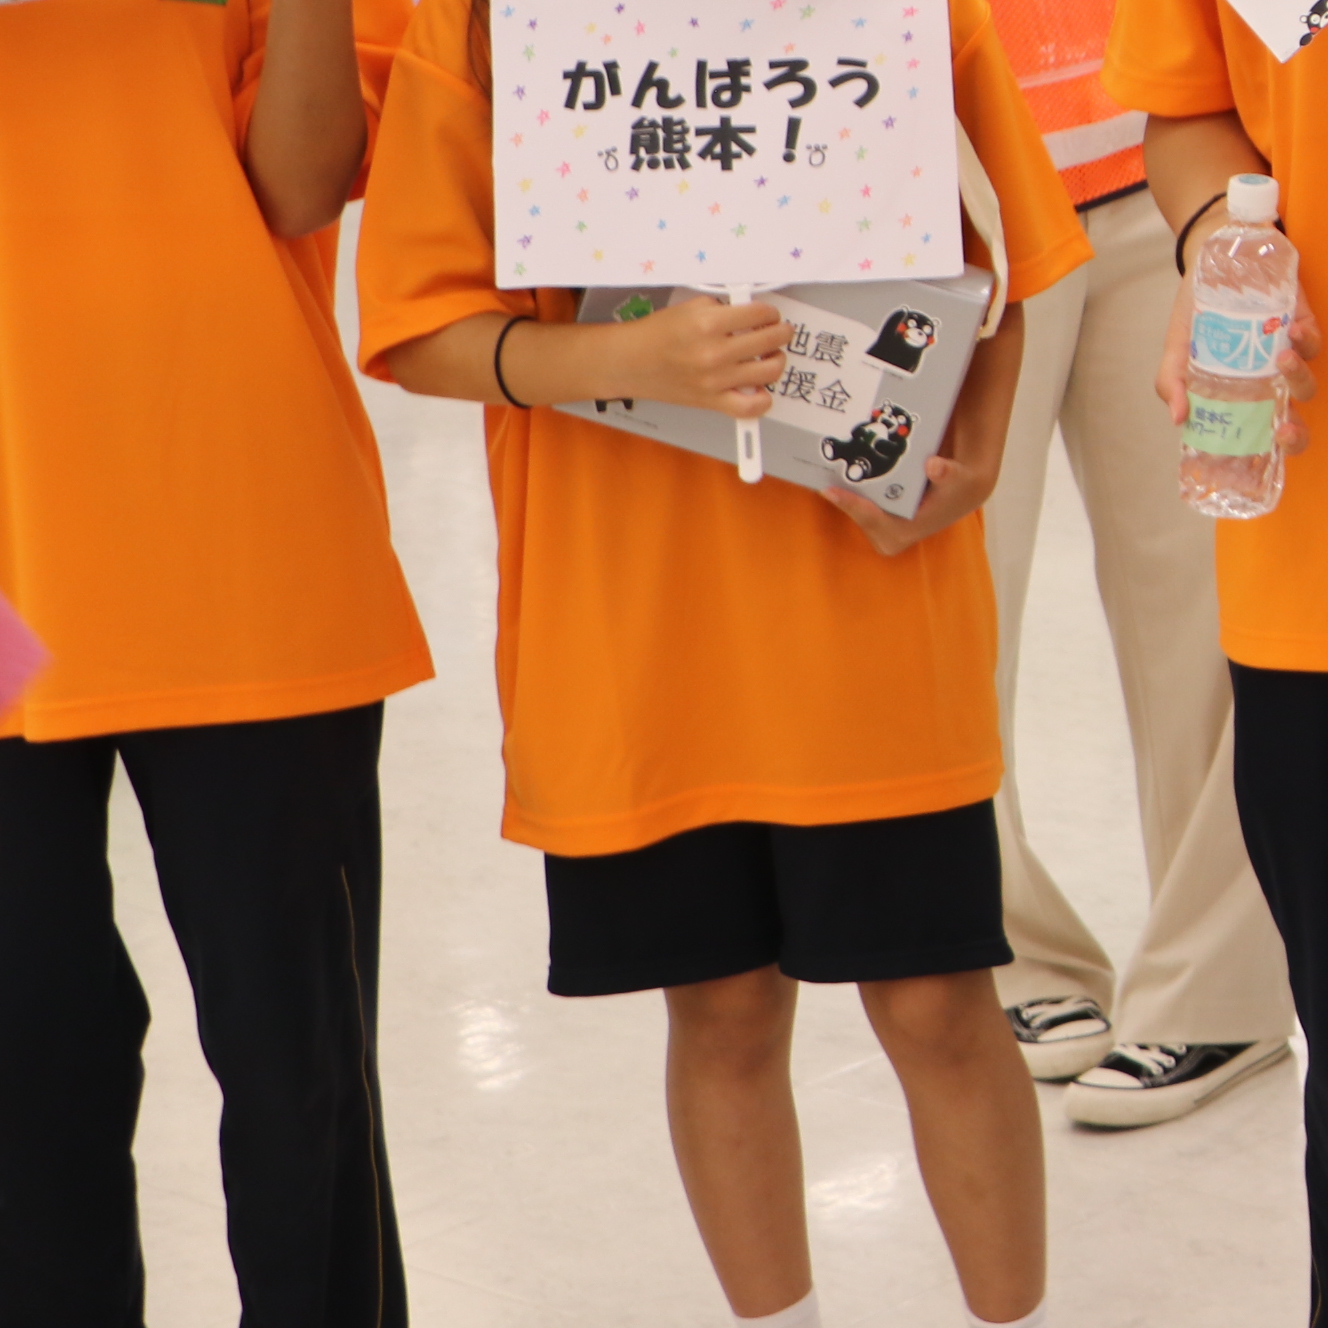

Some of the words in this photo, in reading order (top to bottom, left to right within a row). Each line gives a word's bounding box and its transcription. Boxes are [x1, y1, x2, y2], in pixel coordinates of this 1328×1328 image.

[562, 56, 880, 112] がんばろう
[763, 364, 853, 415] 援金
